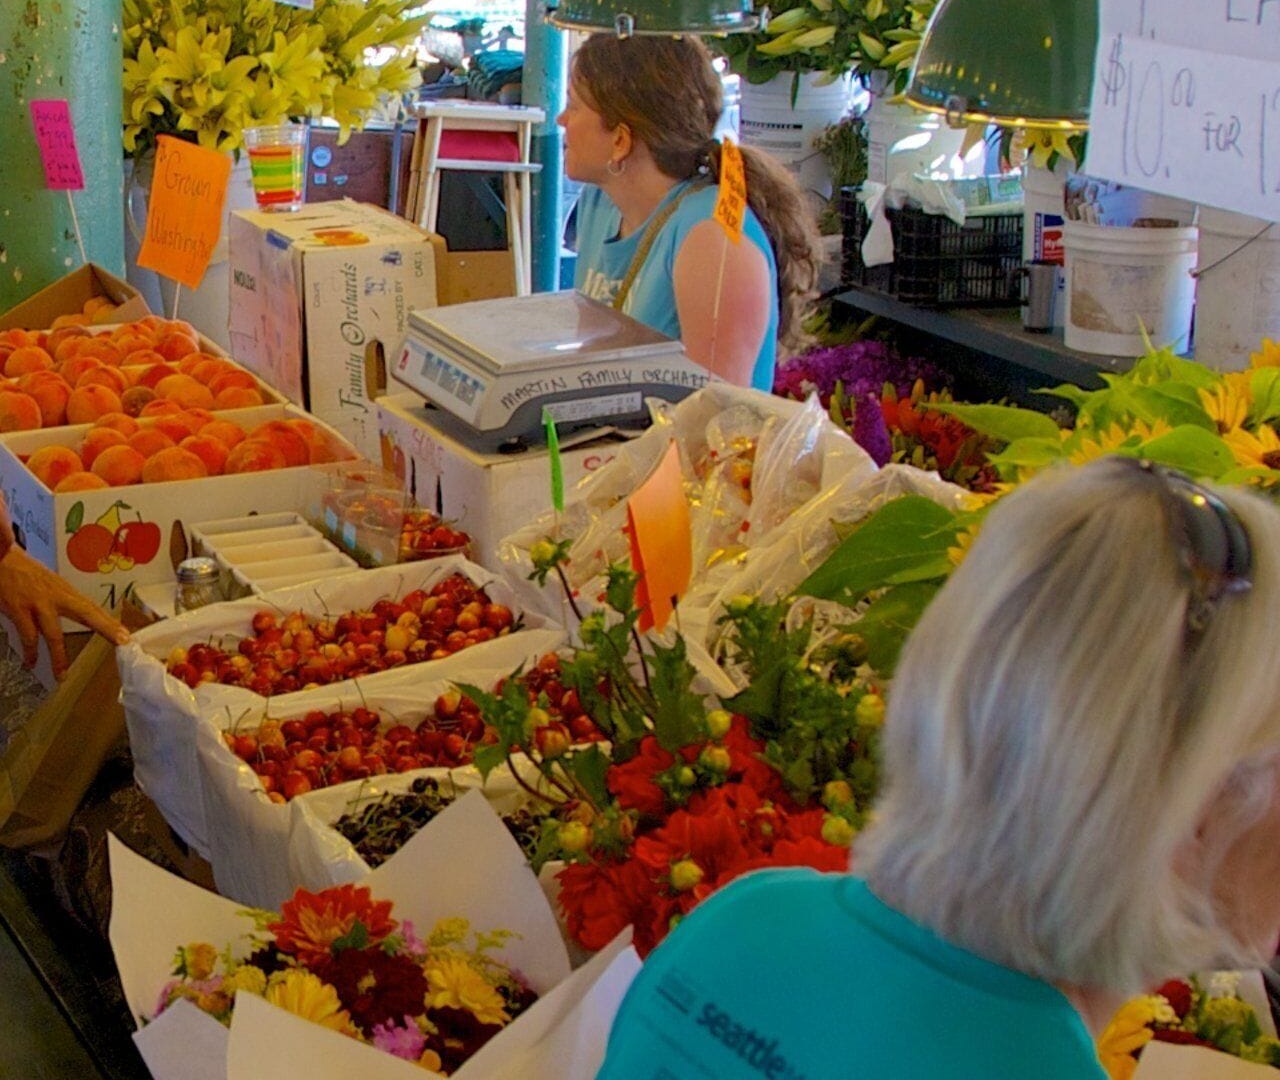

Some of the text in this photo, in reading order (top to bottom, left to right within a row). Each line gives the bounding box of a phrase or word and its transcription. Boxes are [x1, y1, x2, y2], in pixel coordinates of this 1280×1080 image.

[1203, 113, 1243, 157] FOR
[341, 263, 366, 346] Orchards
[339, 353, 368, 413] Family
[500, 376, 567, 410] MARTIN
[578, 367, 632, 389] FAMILY
[696, 1001, 788, 1080] seattle
